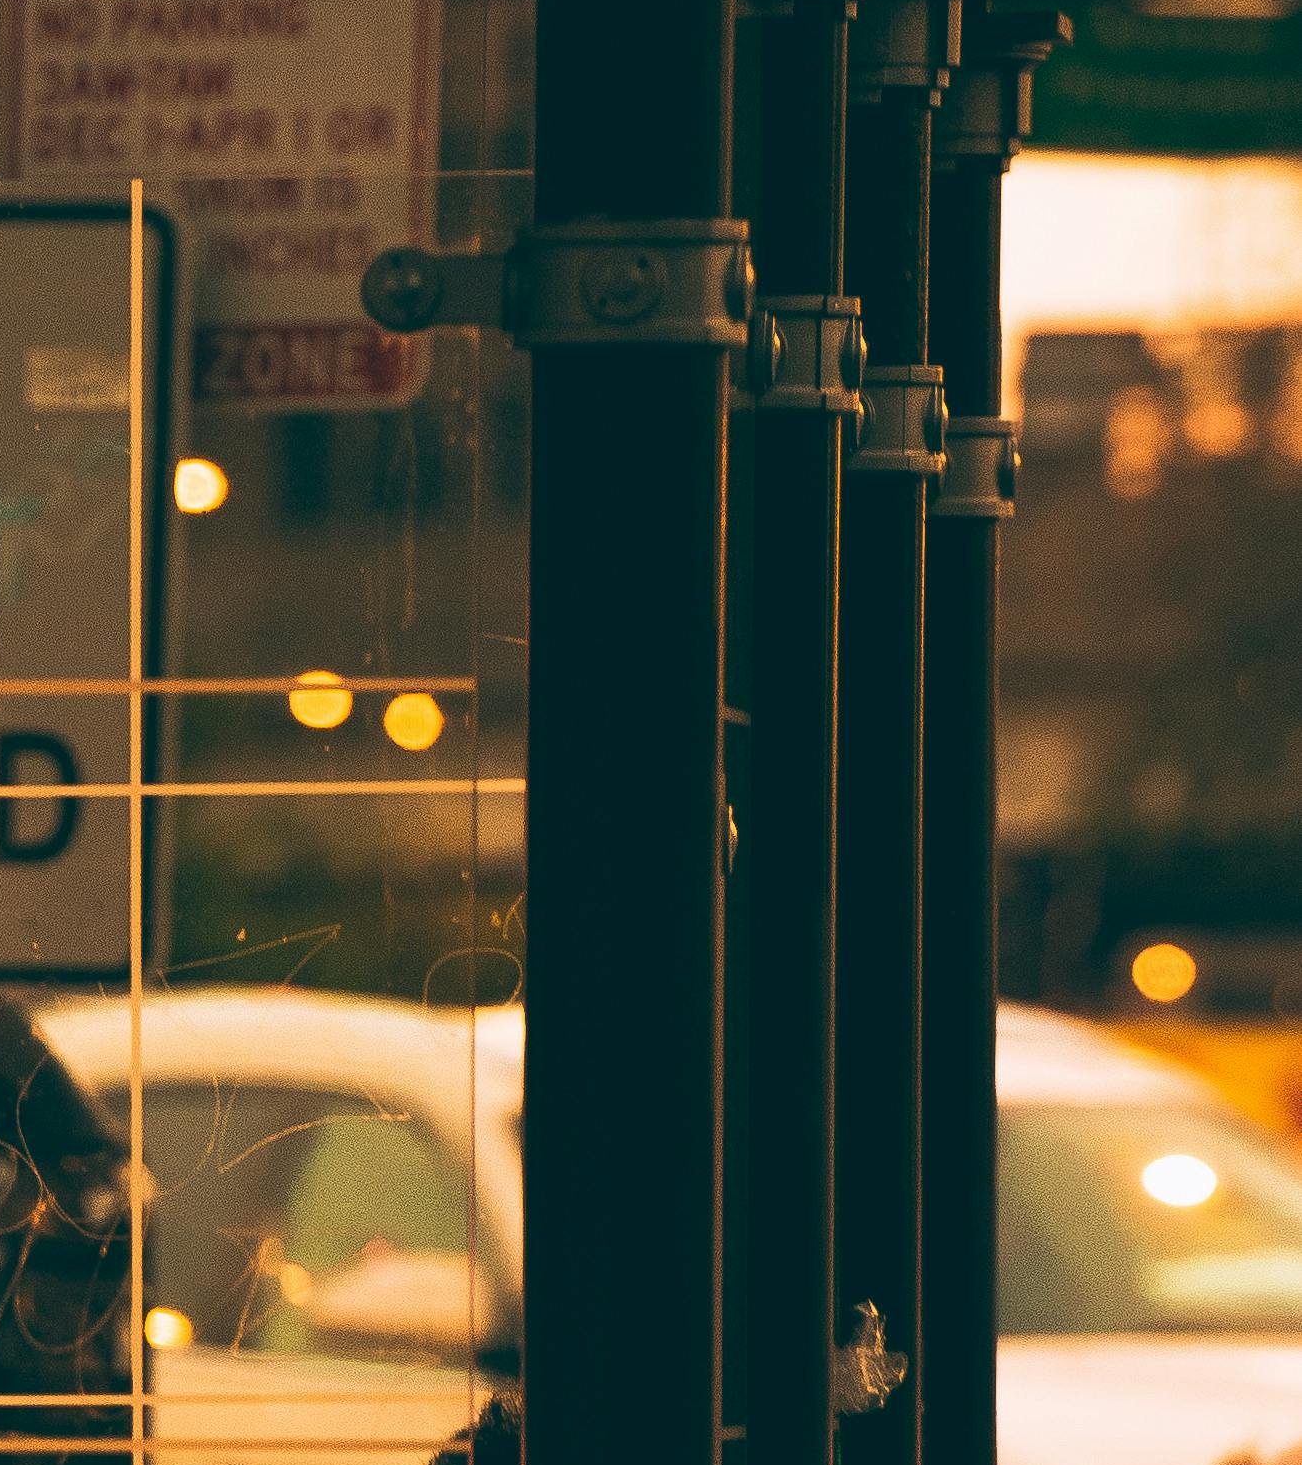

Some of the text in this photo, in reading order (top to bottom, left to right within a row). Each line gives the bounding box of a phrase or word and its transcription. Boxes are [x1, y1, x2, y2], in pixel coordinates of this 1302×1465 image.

[36, 2, 96, 46] NO
[32, 114, 126, 163] DEC
[205, 331, 371, 394] ZONE
